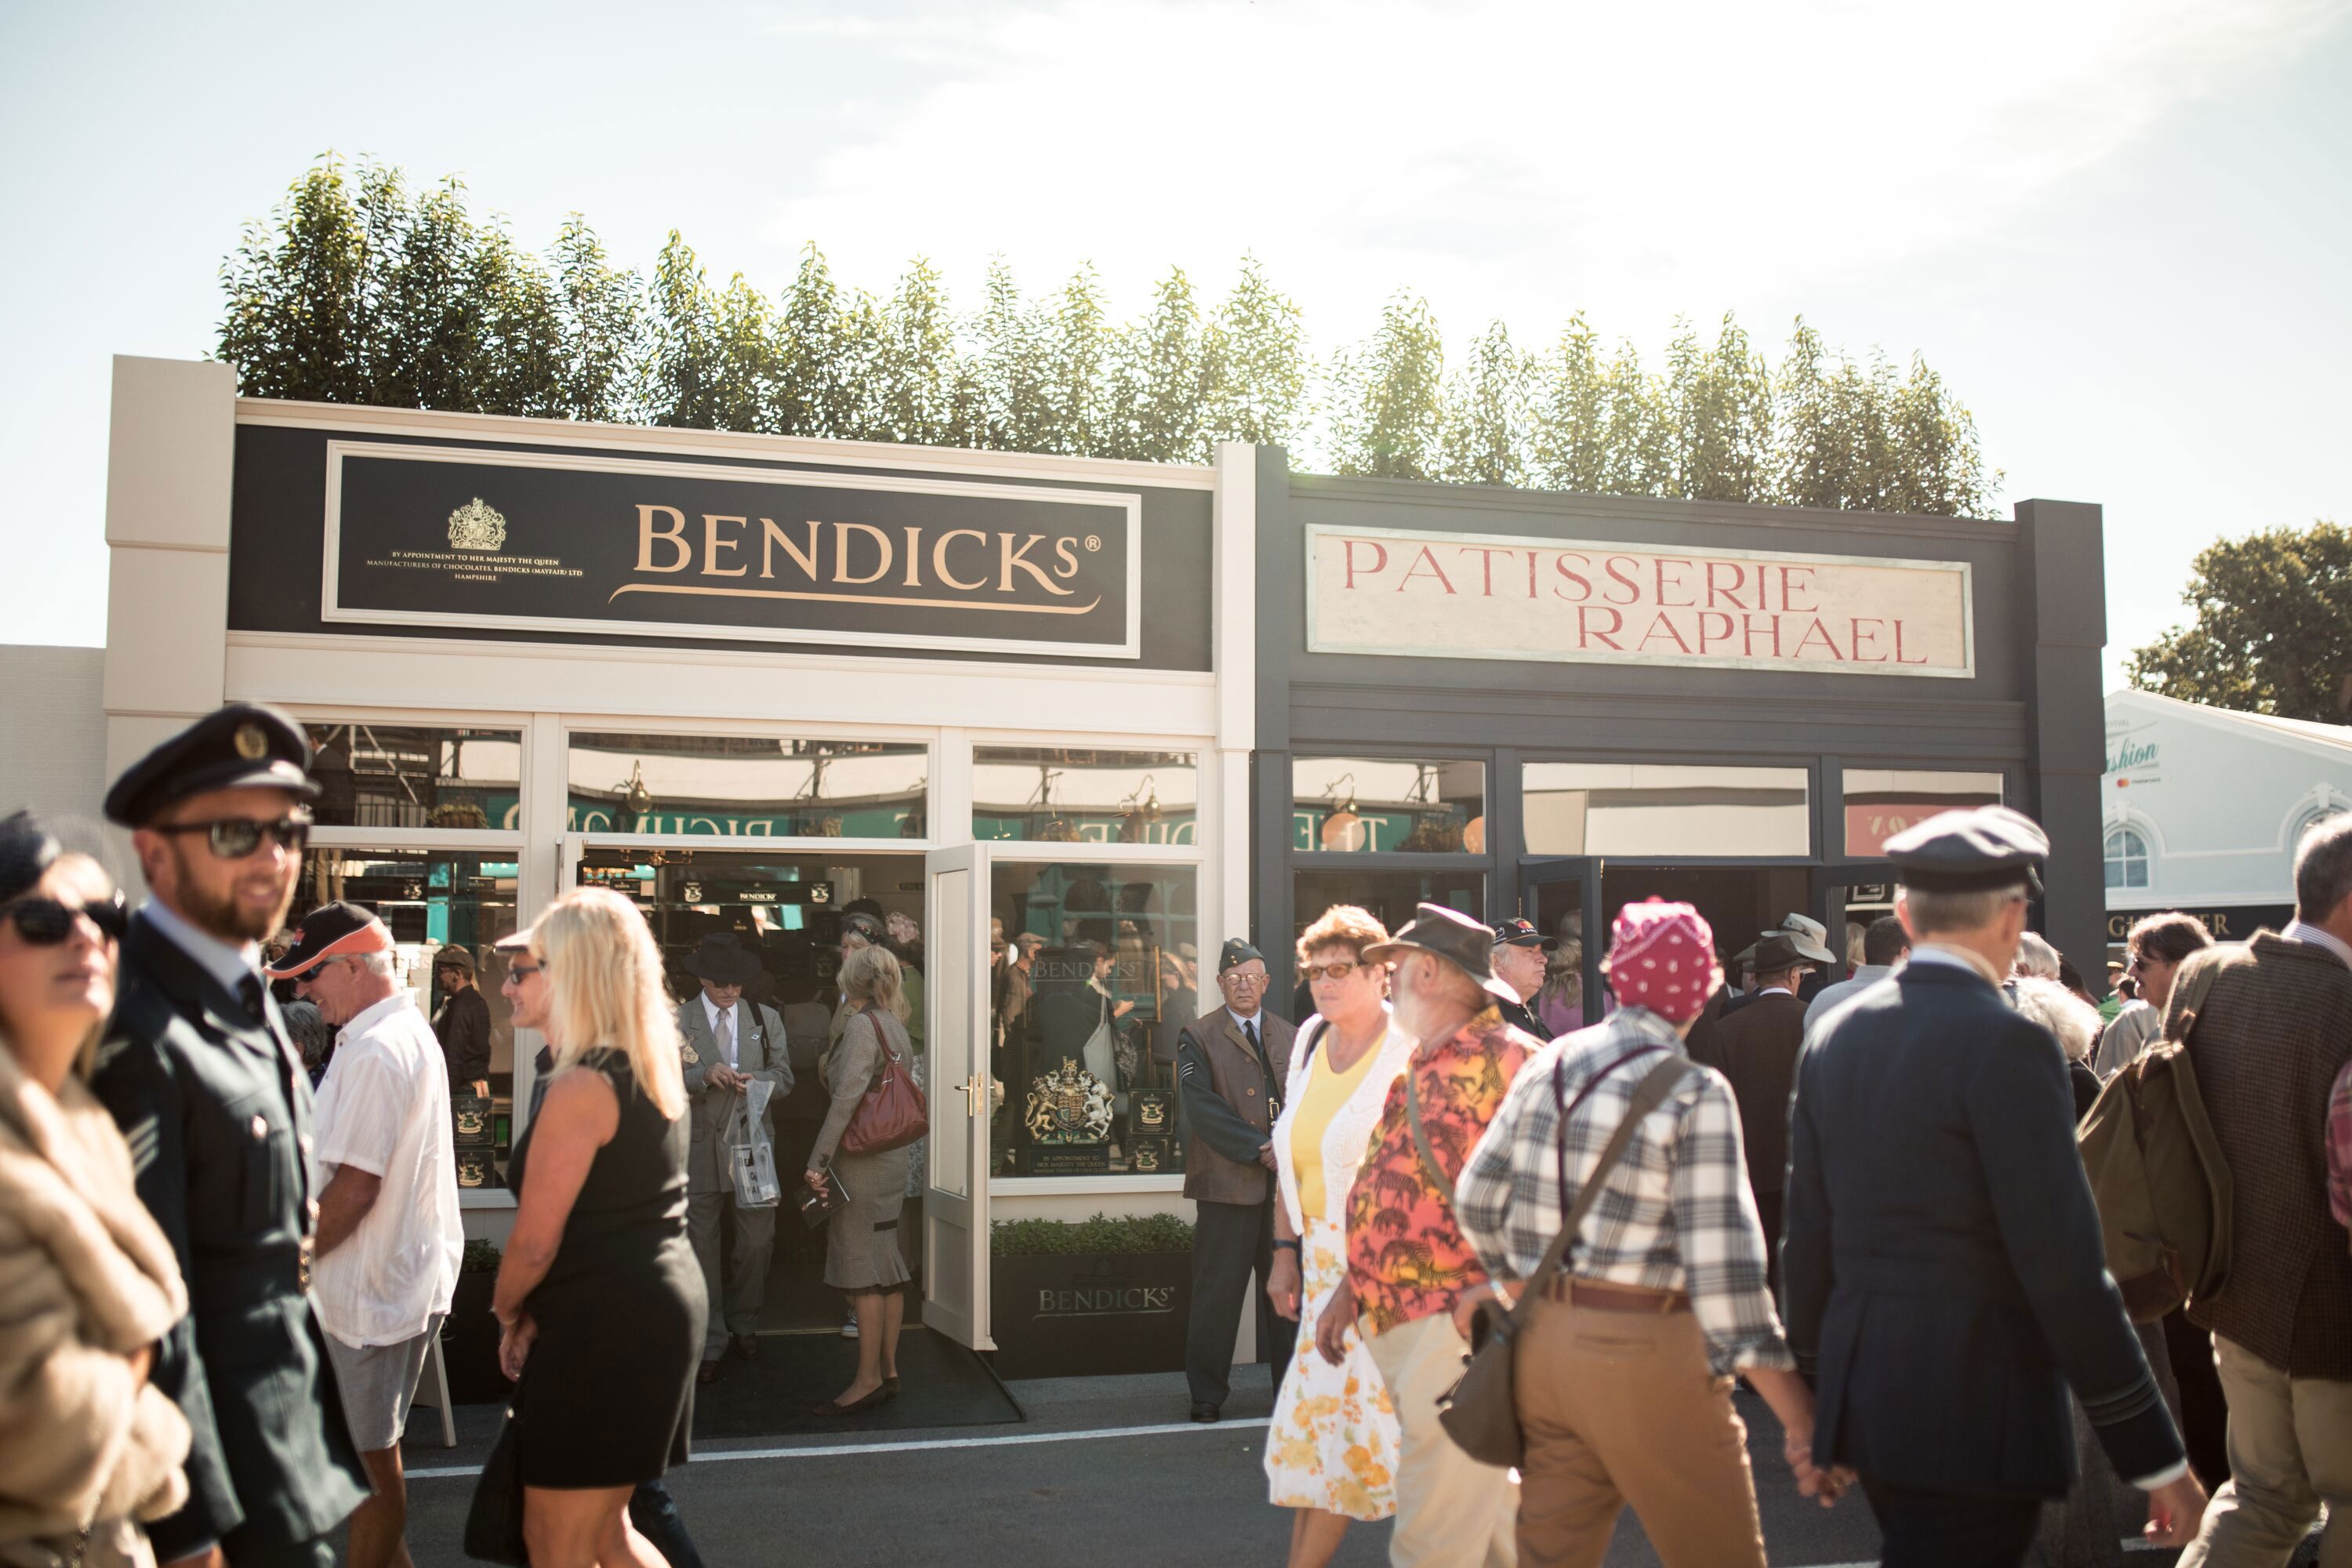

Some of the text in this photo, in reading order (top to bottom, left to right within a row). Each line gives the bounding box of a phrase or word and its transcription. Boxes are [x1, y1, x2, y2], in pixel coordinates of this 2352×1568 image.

[366, 560, 430, 568] MANUFACTURERS
[402, 551, 456, 561] APPOINTMENT
[1341, 539, 1820, 612] PATISSERIE
[1577, 605, 1929, 665] RAPHAEL
